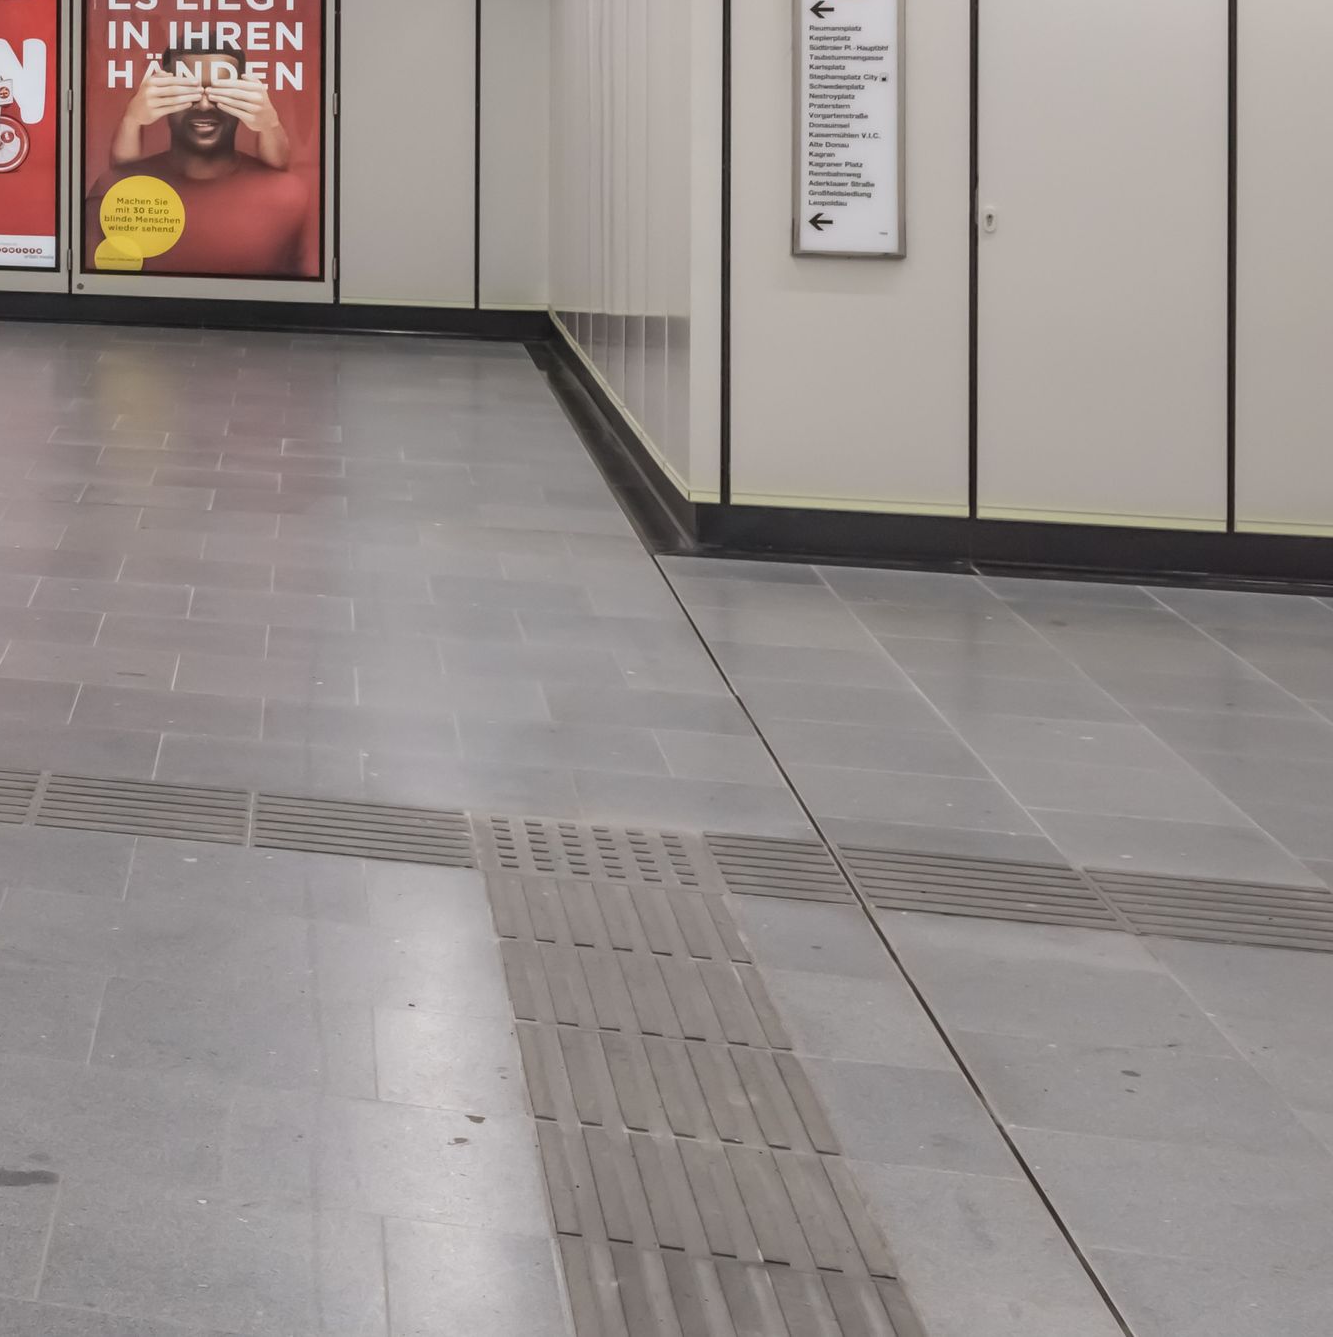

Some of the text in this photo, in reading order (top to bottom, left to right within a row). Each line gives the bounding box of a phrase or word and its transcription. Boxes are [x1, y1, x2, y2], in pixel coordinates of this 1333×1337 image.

[809, 24, 862, 32] Reumannplatz
[108, 20, 303, 51] IN IHREN
[107, 53, 303, 91] HÄNDEN
[809, 73, 879, 81] Stephansplatz City
[809, 83, 865, 91] Schwedenplatz
[809, 112, 869, 120] Vorgartenstraße
[809, 131, 860, 139] Kaisermühlen
[850, 180, 875, 188] Straße
[116, 197, 168, 206] Machen Sie
[148, 207, 169, 215] Euro
[104, 215, 181, 224] blinde Menschen
[108, 224, 139, 232] wieder
